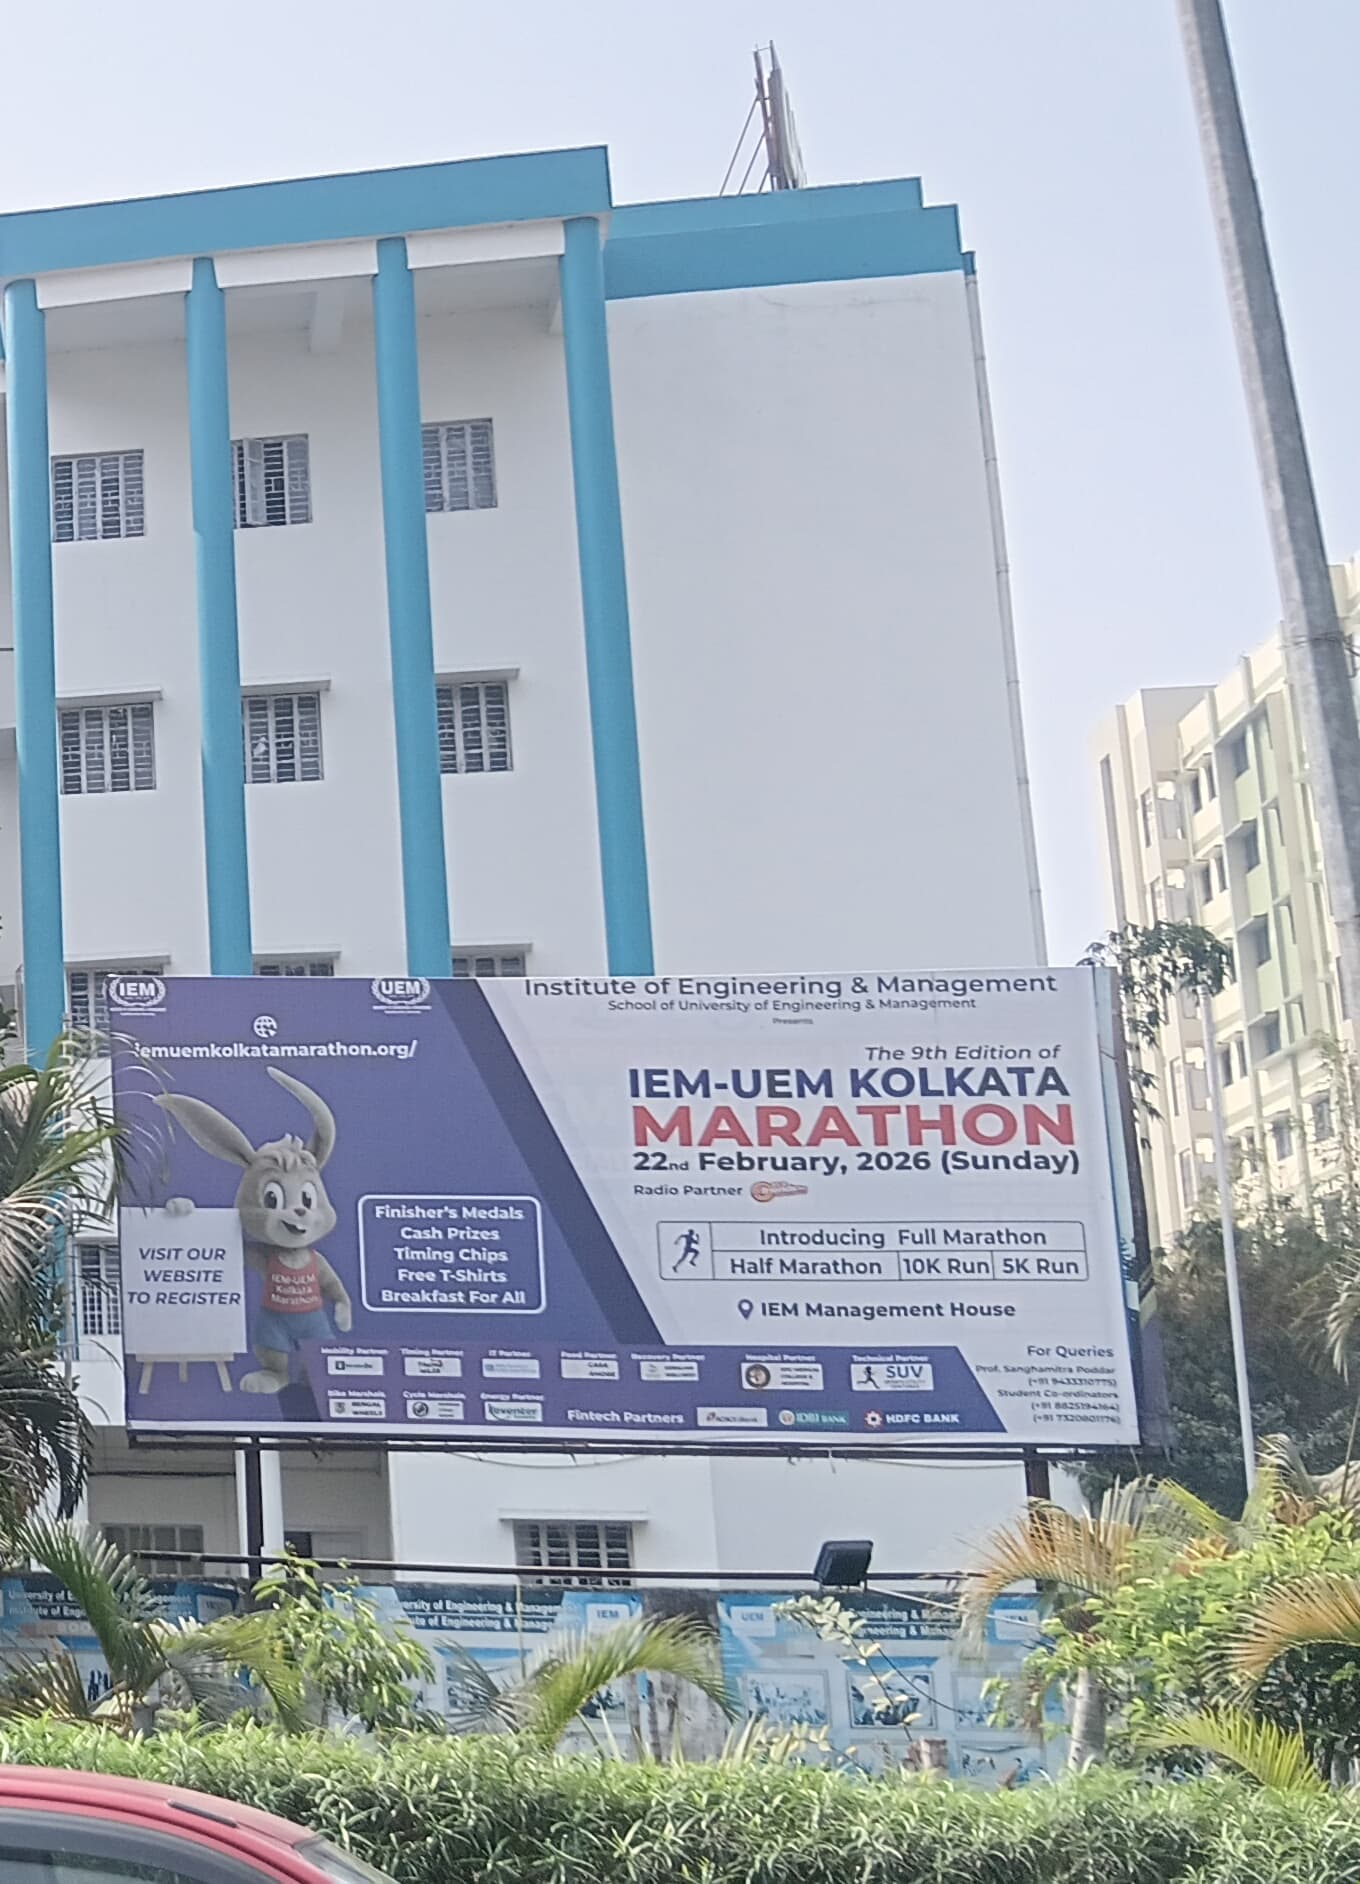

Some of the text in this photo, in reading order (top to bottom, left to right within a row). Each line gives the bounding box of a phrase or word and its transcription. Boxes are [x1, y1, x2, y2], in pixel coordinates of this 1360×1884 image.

[118, 982, 156, 998] IEM
[380, 980, 422, 996] UEM
[525, 974, 1057, 1000] Institute of Engineering & Management
[608, 997, 977, 1013] School of University of Engineering & Management
[865, 1044, 1063, 1062] The 9th Edition of
[628, 1066, 1071, 1099] IEM-UEM KOLKATA
[631, 1103, 1075, 1148] MARATHON
[633, 1149, 1080, 1177] 22nd February, 2026 (Sunday)
[633, 1184, 679, 1197] Radio
[683, 1184, 743, 1197] Partner
[374, 1205, 524, 1221] Finisher's Medals
[400, 1226, 500, 1242] Cash Prizes
[759, 1227, 1048, 1249] Introducing Full Marathon
[138, 1247, 227, 1262] VISIT OUR
[394, 1247, 509, 1264] Timing Chips
[730, 1257, 1080, 1275] Half Marathon 10K Run 5K Run
[143, 1269, 224, 1284] WEBSITE
[398, 1268, 509, 1283] Free T-Shirts
[127, 1291, 242, 1306] TO REGISTER
[381, 1288, 527, 1305] Breakfast For All
[761, 1301, 1017, 1320] IEM Management House
[1027, 1345, 1115, 1359] For Queries
[885, 1365, 924, 1379] SUV
[566, 1409, 685, 1425] Fintech Partners
[885, 1413, 960, 1424] HDFC BANK
